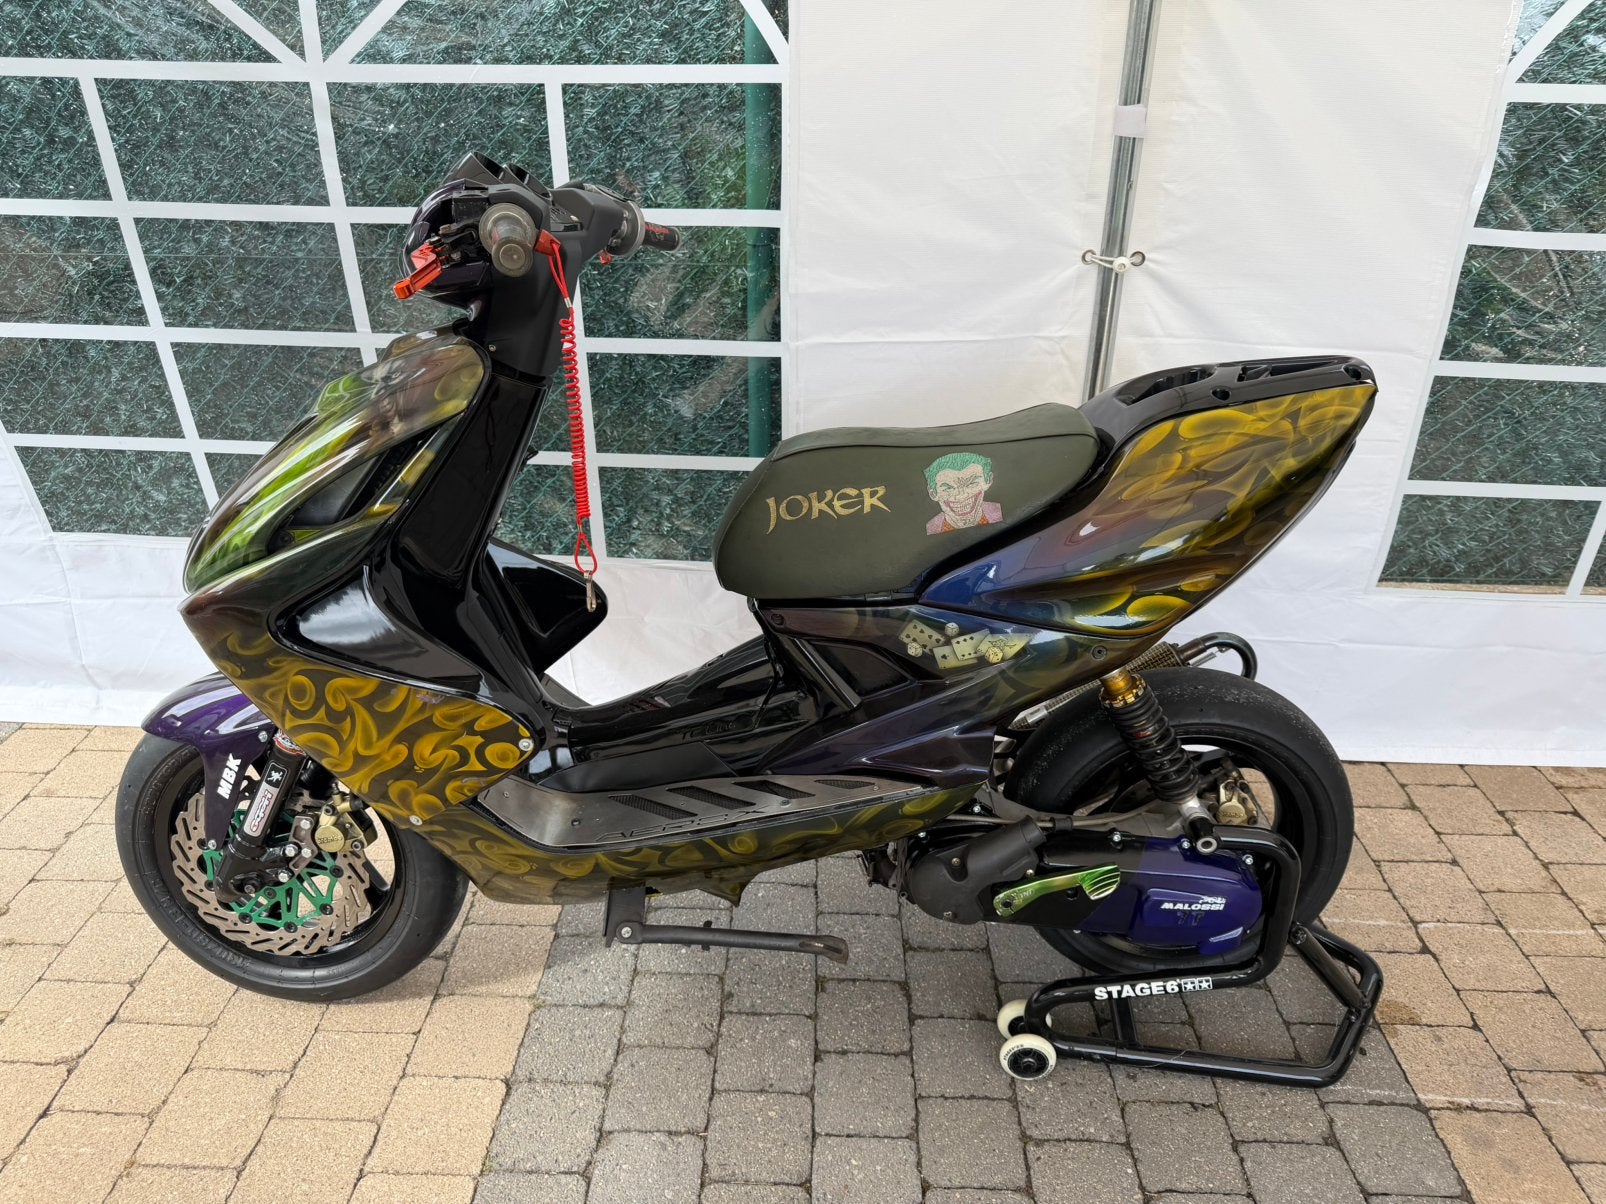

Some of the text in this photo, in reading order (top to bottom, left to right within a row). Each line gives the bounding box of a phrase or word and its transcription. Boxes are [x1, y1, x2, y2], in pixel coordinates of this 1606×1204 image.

[765, 485, 892, 535] JOKER
[217, 752, 242, 800] MBK
[1160, 902, 1225, 911] MALOSSI
